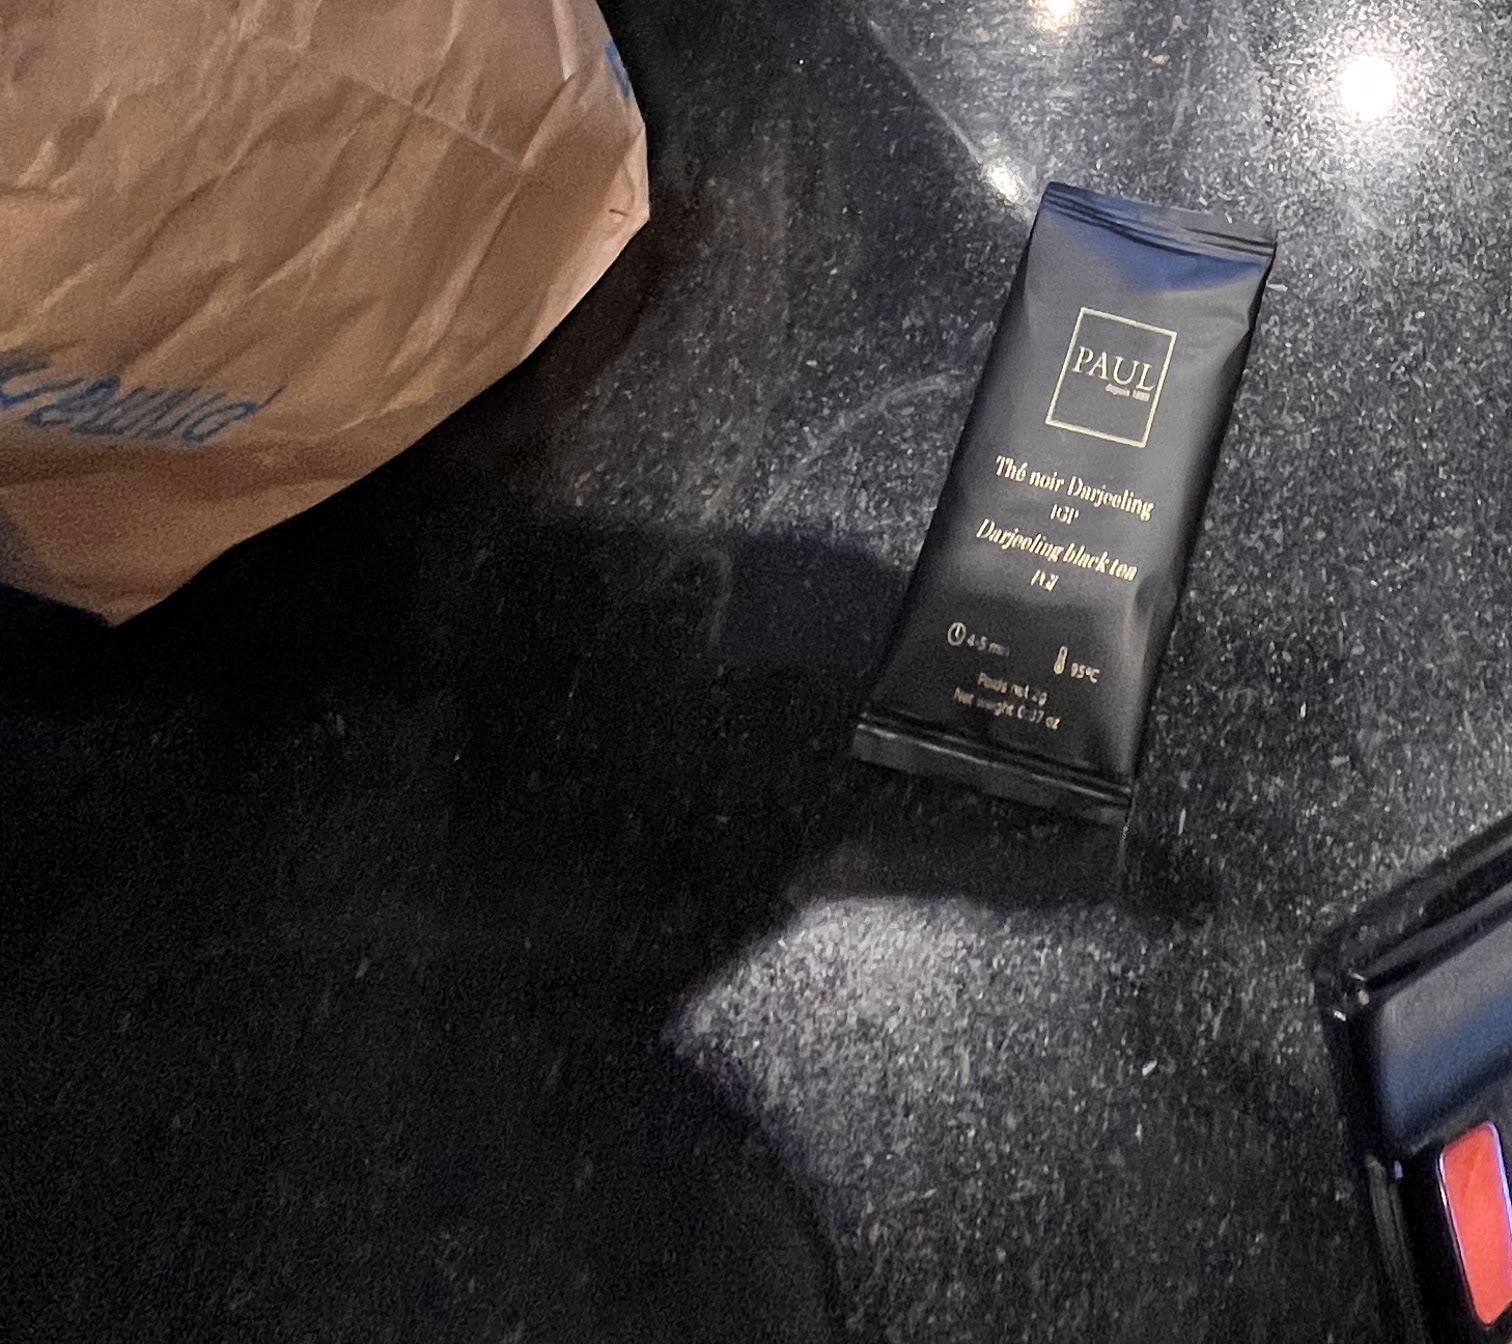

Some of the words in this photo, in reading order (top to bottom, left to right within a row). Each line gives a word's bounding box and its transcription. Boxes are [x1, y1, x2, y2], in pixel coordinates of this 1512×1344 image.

[1071, 345, 1156, 391] PAUL
[995, 454, 1029, 482] Thé
[1028, 471, 1065, 492] noir
[1066, 475, 1155, 522] Darjeeling
[976, 518, 1065, 563] Darjeeling
[1062, 542, 1110, 574] black
